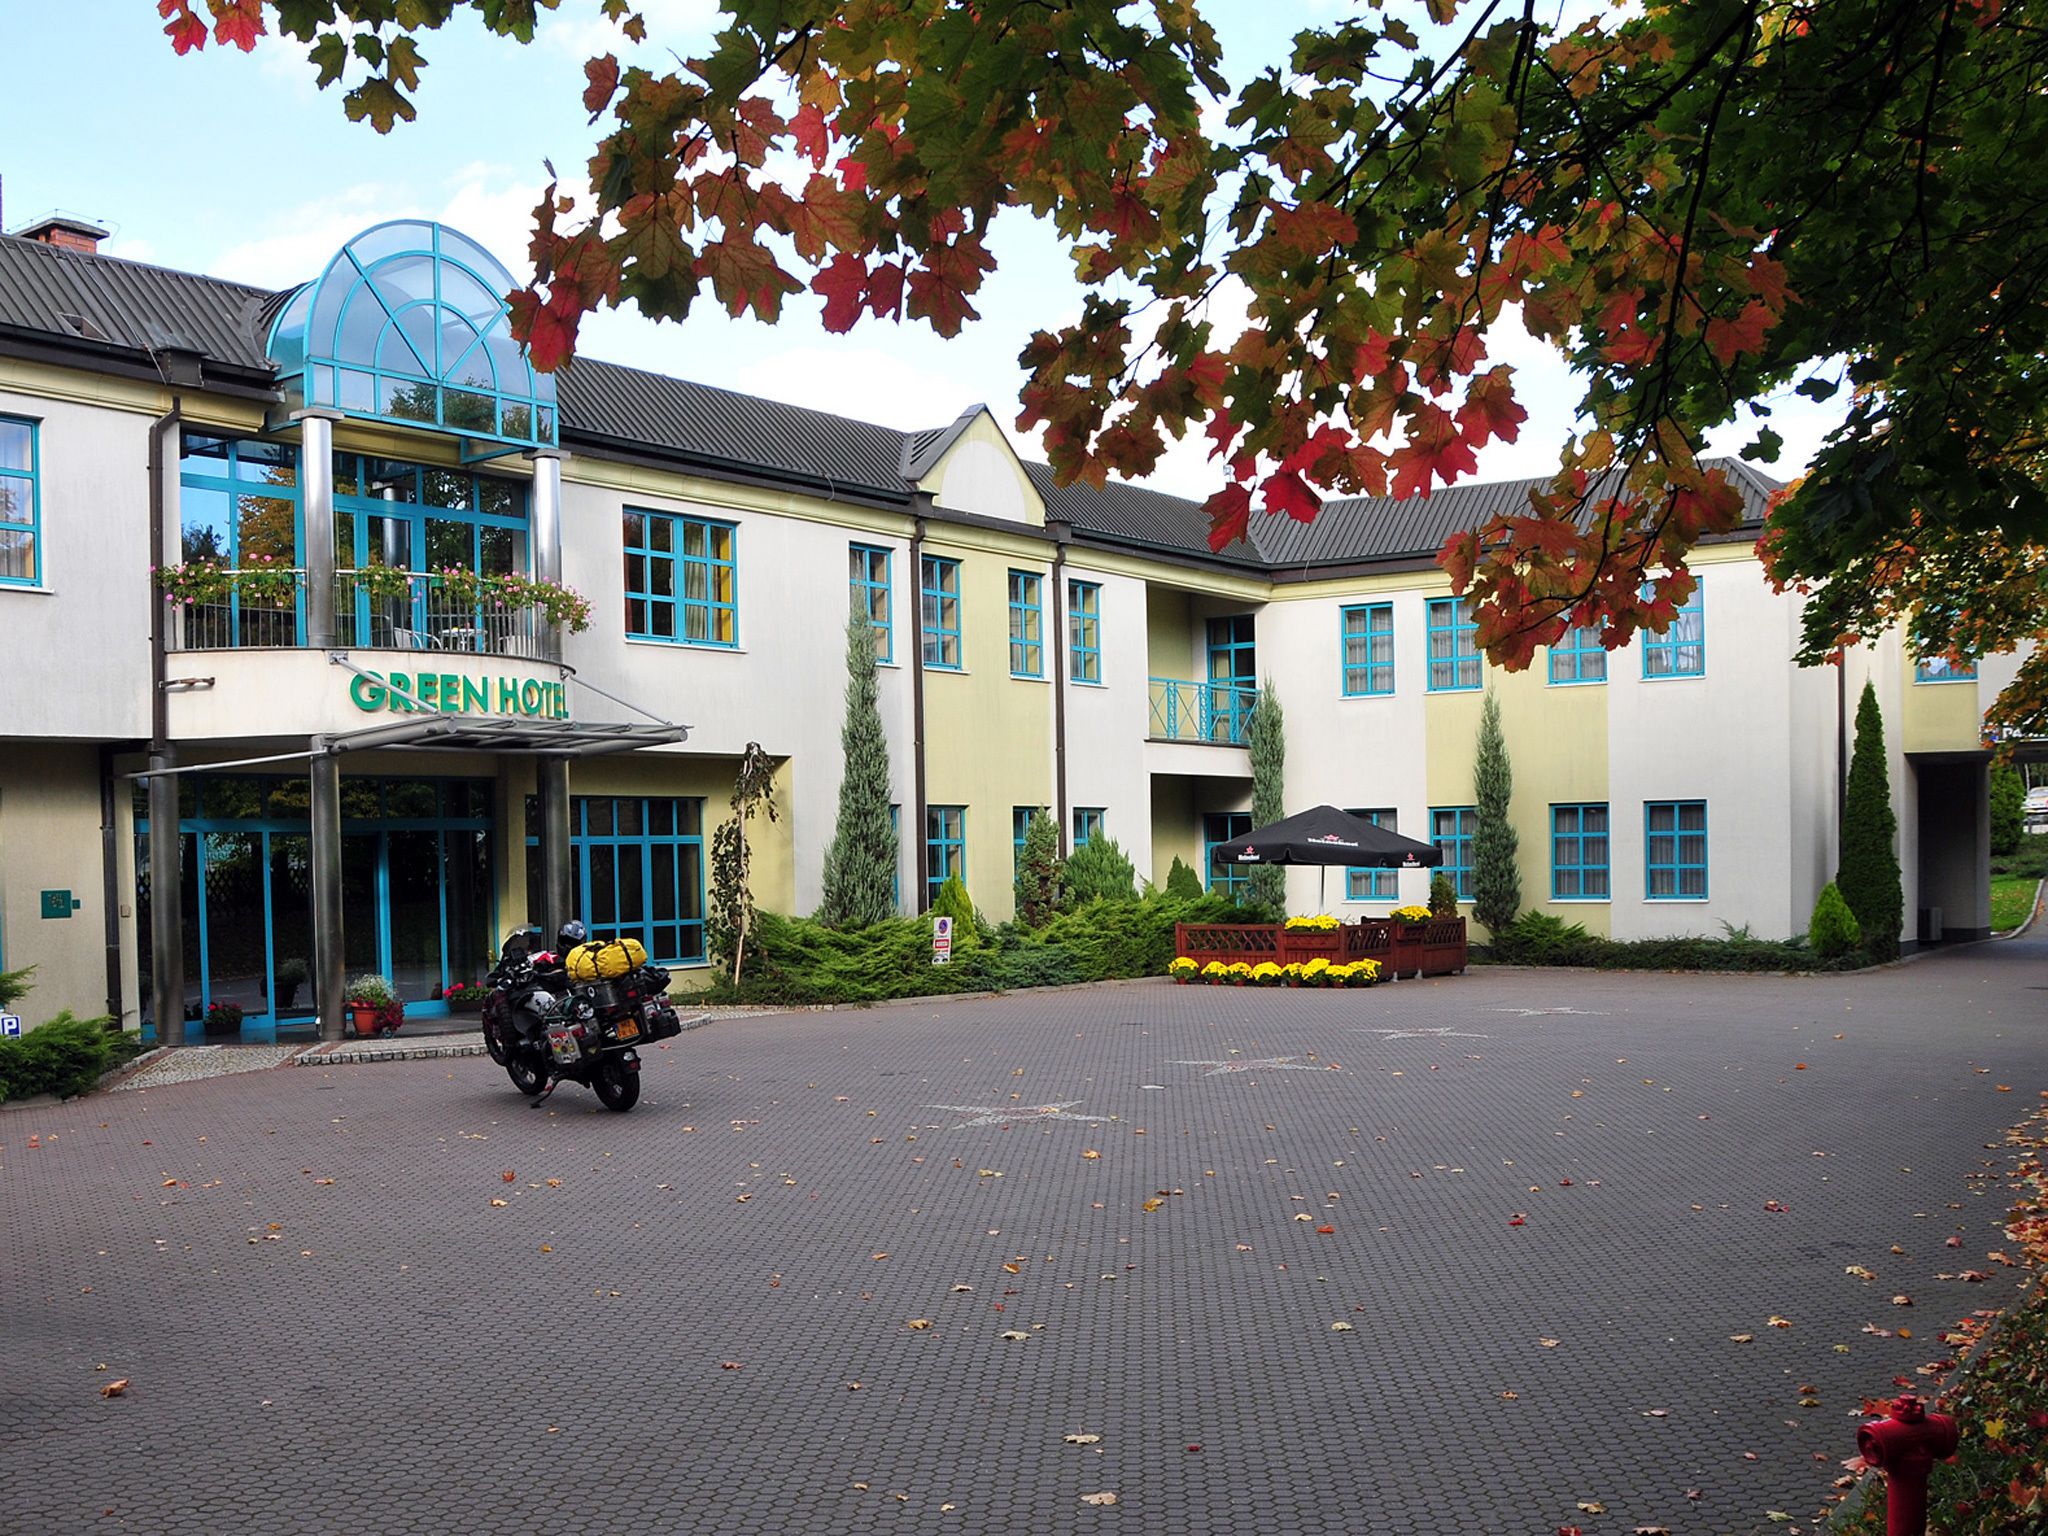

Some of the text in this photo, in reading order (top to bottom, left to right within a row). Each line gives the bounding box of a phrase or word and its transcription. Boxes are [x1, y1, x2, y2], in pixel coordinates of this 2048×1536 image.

[350, 670, 569, 719] GREEN HOTEL
[4, 1018, 17, 1035] P
